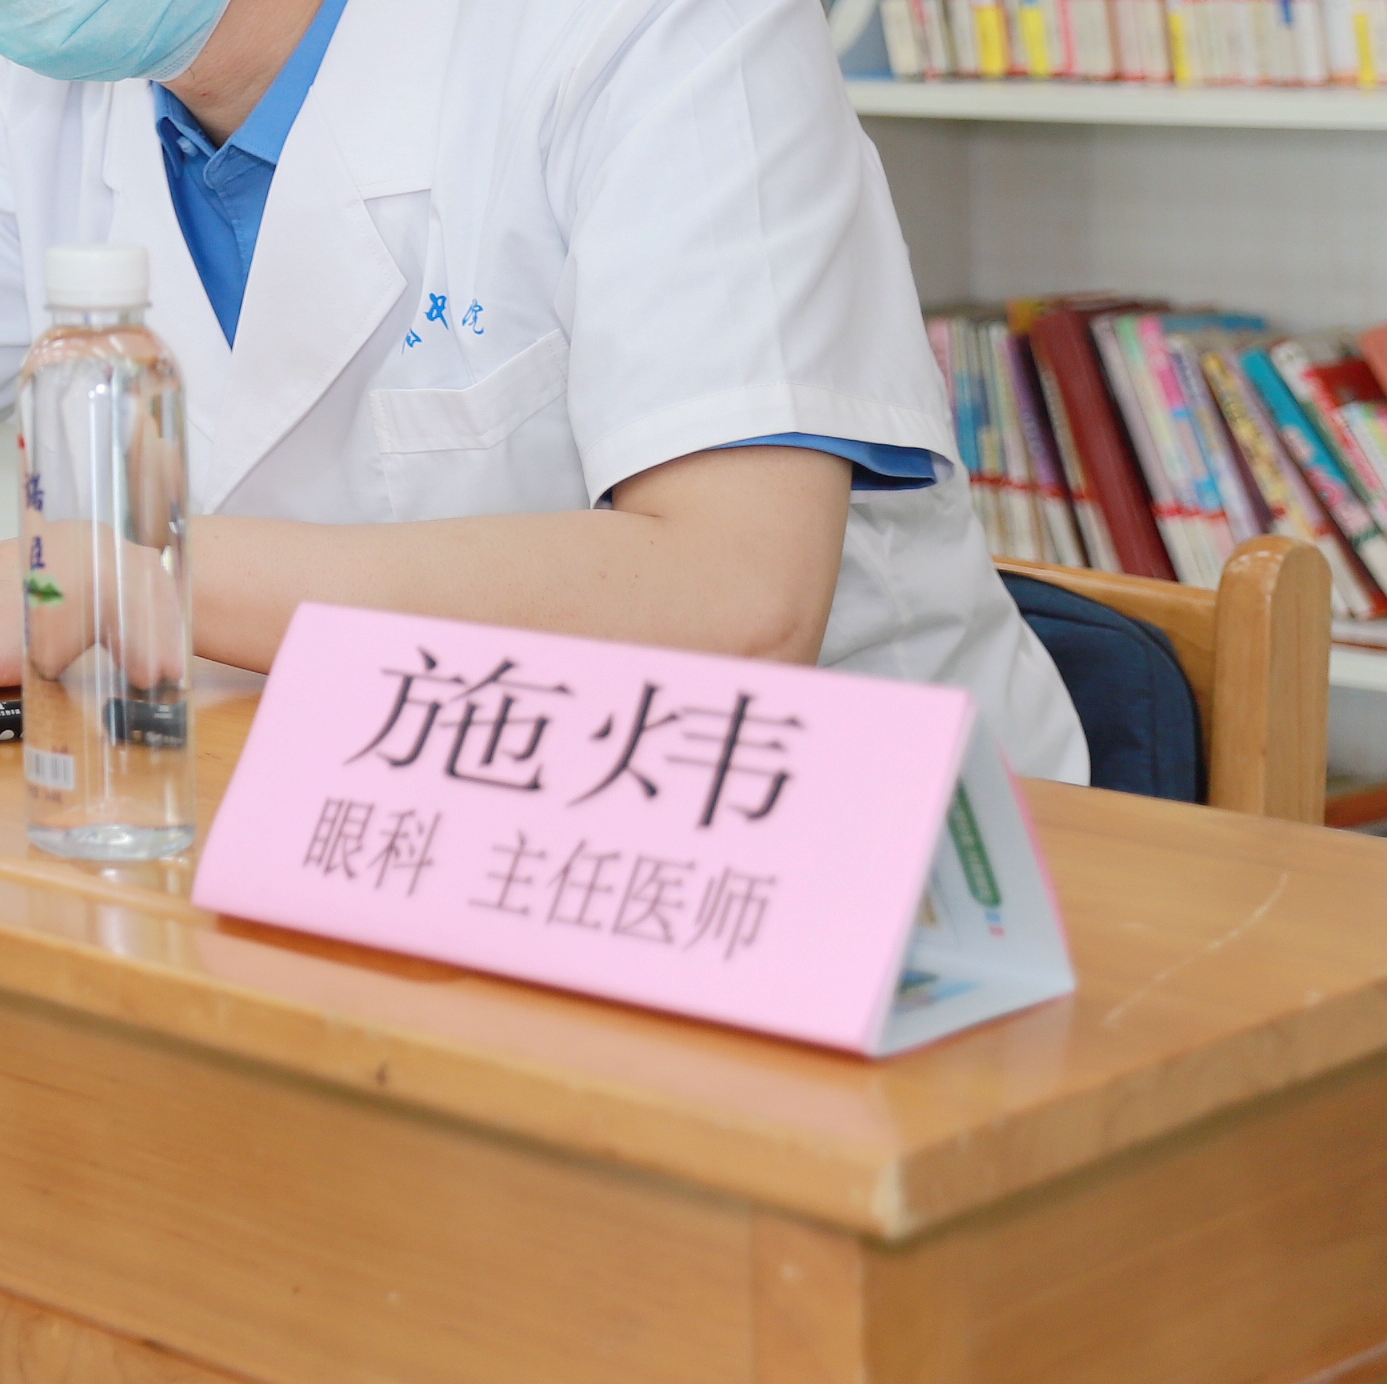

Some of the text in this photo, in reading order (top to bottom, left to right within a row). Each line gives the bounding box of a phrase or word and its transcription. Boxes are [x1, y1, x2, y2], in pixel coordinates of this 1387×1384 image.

[343, 646, 804, 829] 施炜
[302, 797, 777, 962] 眼科 主任医师
